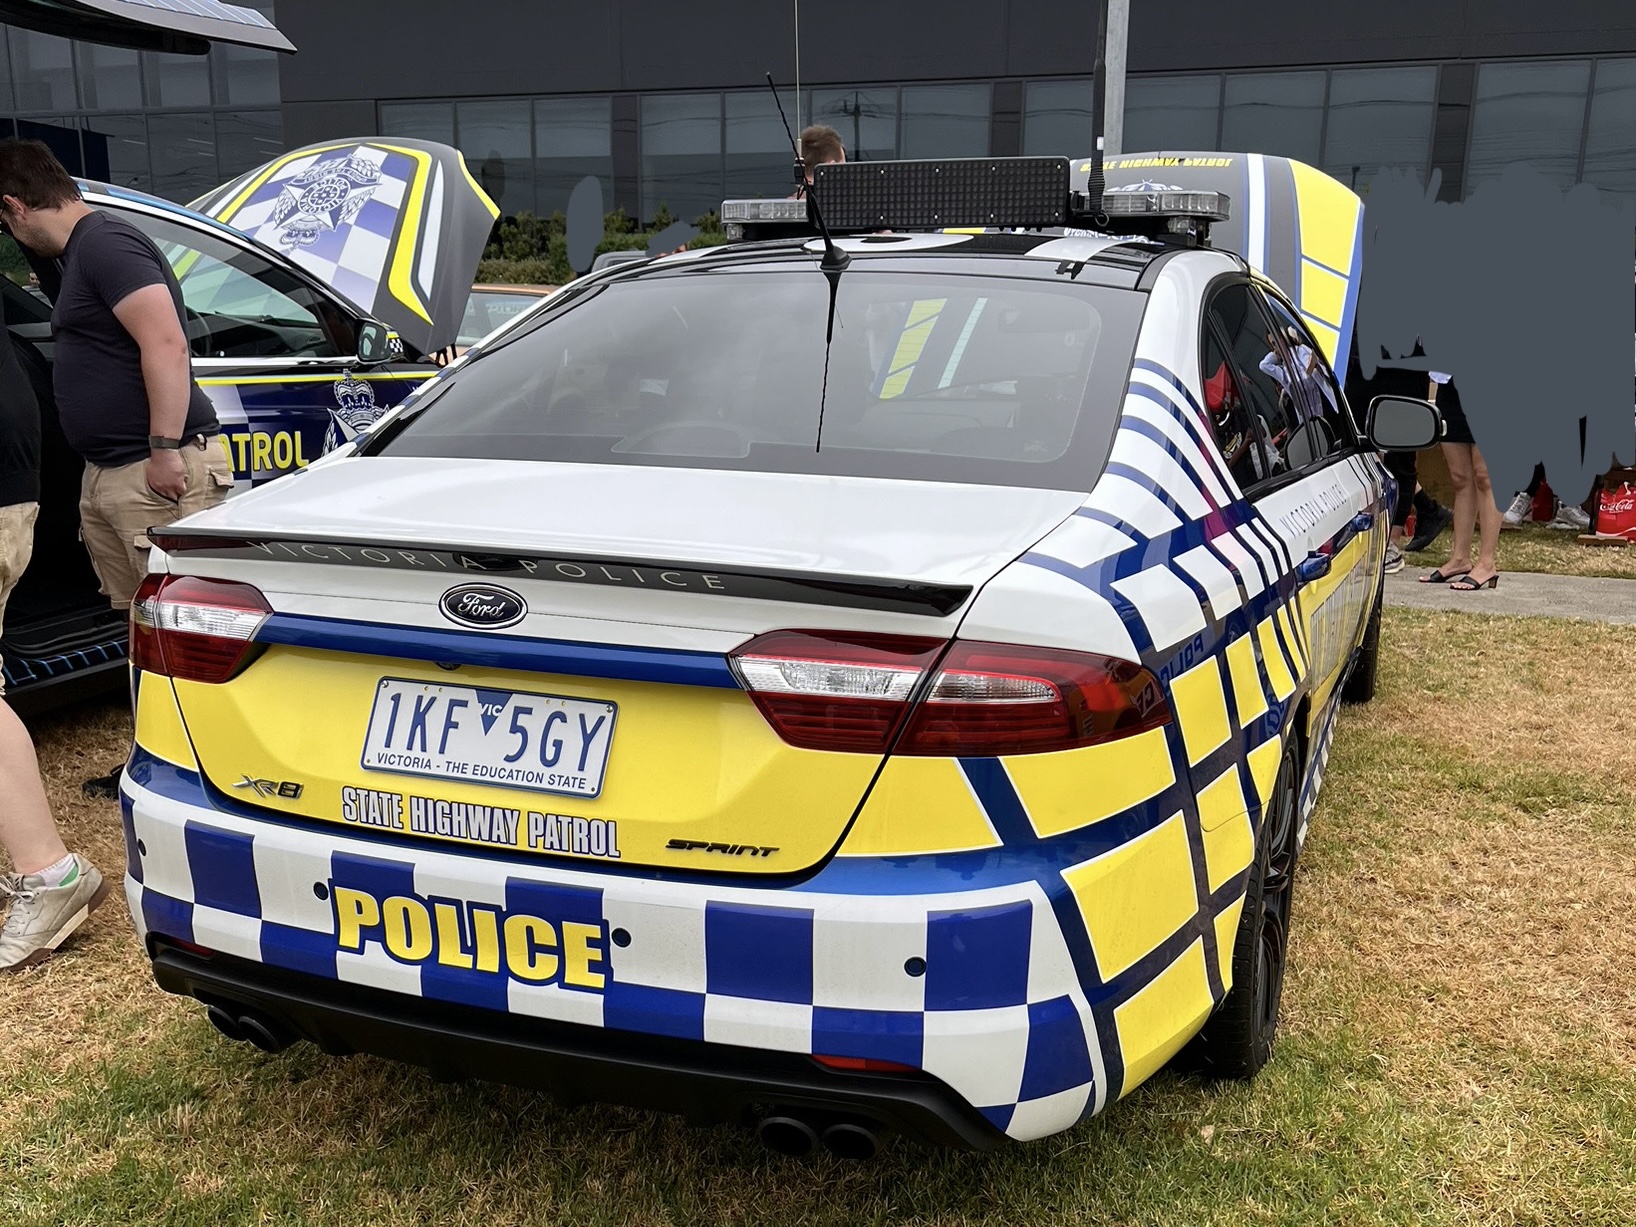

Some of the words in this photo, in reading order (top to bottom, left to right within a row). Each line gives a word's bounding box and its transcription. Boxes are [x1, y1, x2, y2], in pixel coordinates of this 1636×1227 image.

[247, 540, 487, 570] VICTORIA
[518, 559, 725, 590] POLICE
[458, 592, 506, 618] Ford
[478, 702, 503, 716] VIC
[384, 692, 469, 755] 1KF
[503, 705, 606, 772] 5GY
[232, 773, 304, 799] XR8
[377, 752, 432, 770] VICTORIA
[445, 761, 469, 774] THE
[472, 764, 545, 784] EDUCATION
[547, 773, 587, 790] STATE
[342, 786, 404, 830] STATE
[410, 796, 520, 846] HIGHWAY
[528, 811, 621, 858] PATROL
[665, 838, 780, 857] SPRINT
[334, 885, 606, 989] POLICE
